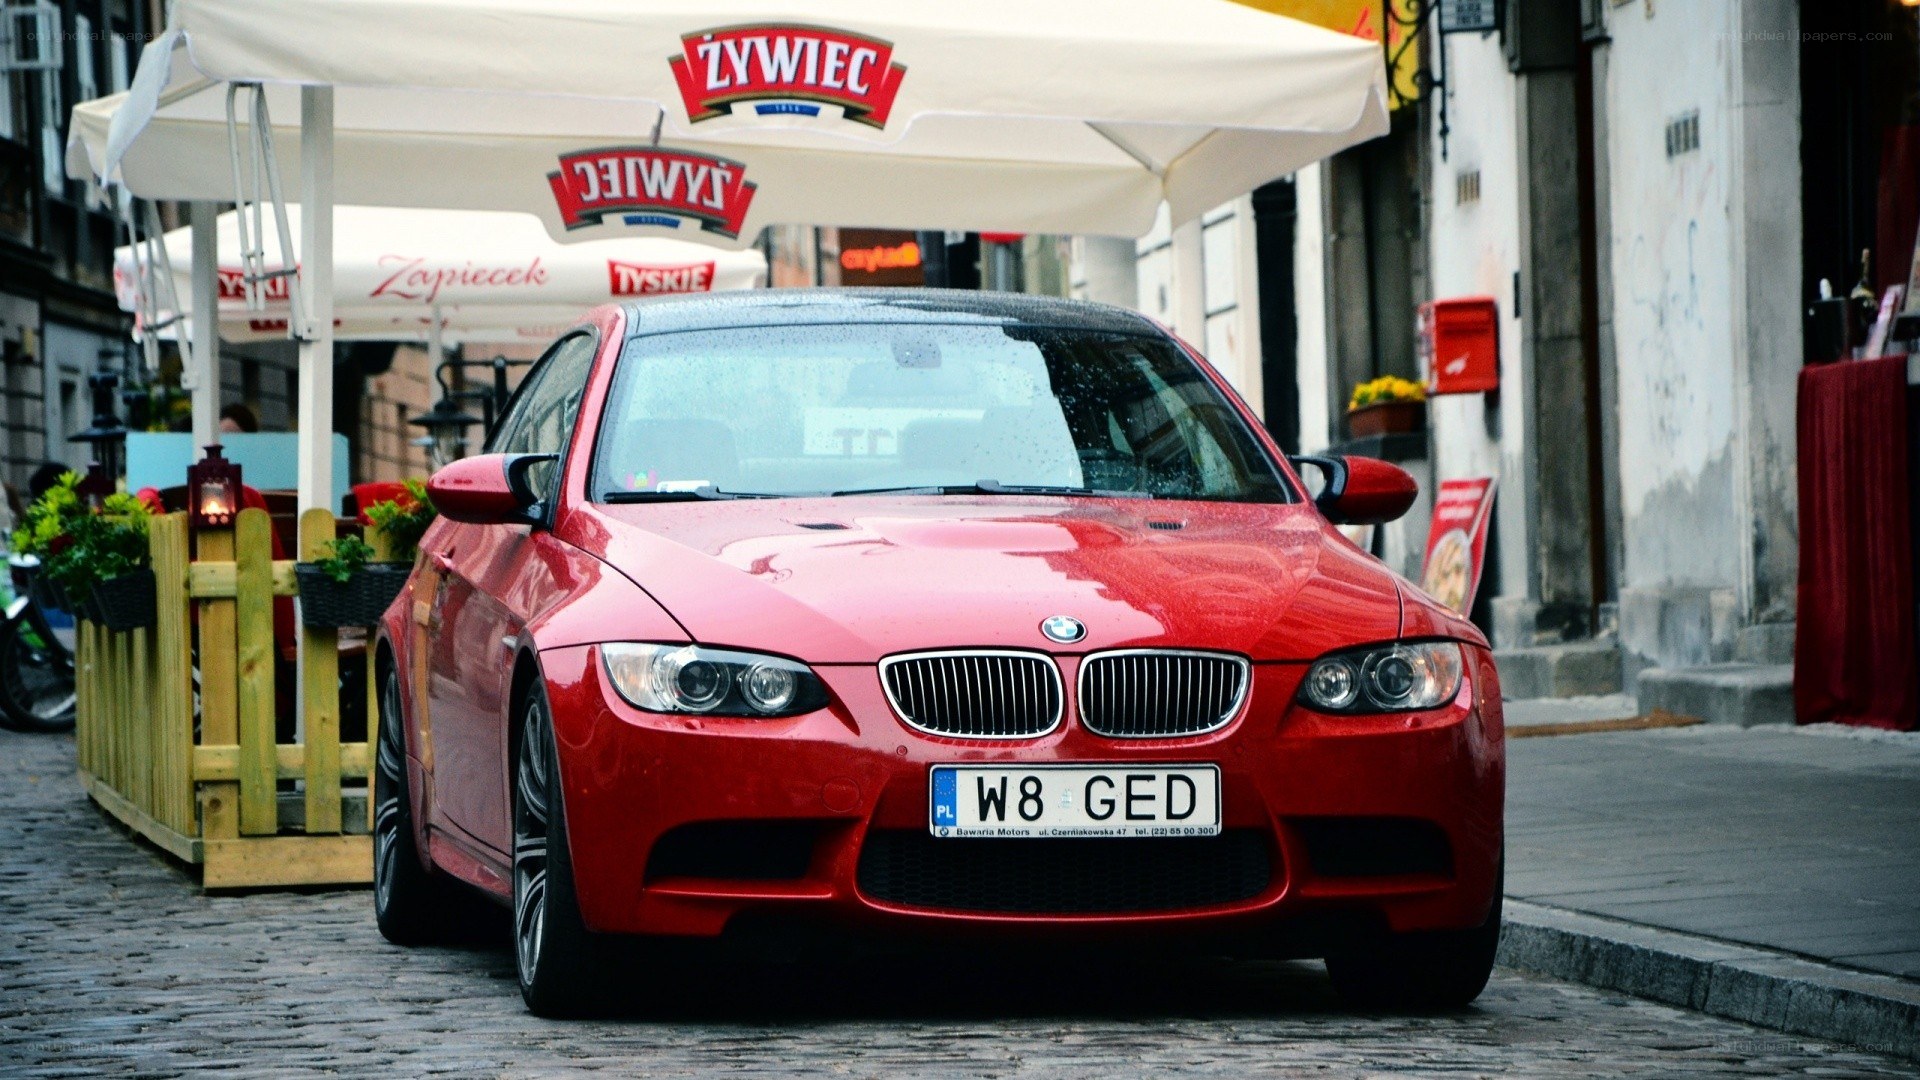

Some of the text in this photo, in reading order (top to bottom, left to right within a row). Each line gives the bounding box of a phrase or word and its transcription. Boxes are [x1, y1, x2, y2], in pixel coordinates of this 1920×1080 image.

[697, 34, 877, 95] ŻYWIEC
[369, 254, 551, 303] Zapiecek
[614, 265, 709, 292] TYSKIE
[936, 805, 954, 818] PL
[977, 774, 1196, 822] W8 GED
[956, 828, 996, 836] Bawaria
[997, 828, 1030, 836] Motors
[1038, 828, 1049, 836] ul.
[1051, 828, 1114, 836] Czerniakowska
[1151, 827, 1168, 836] (22)
[1184, 827, 1195, 835] 00
[1197, 827, 1214, 835] 300
